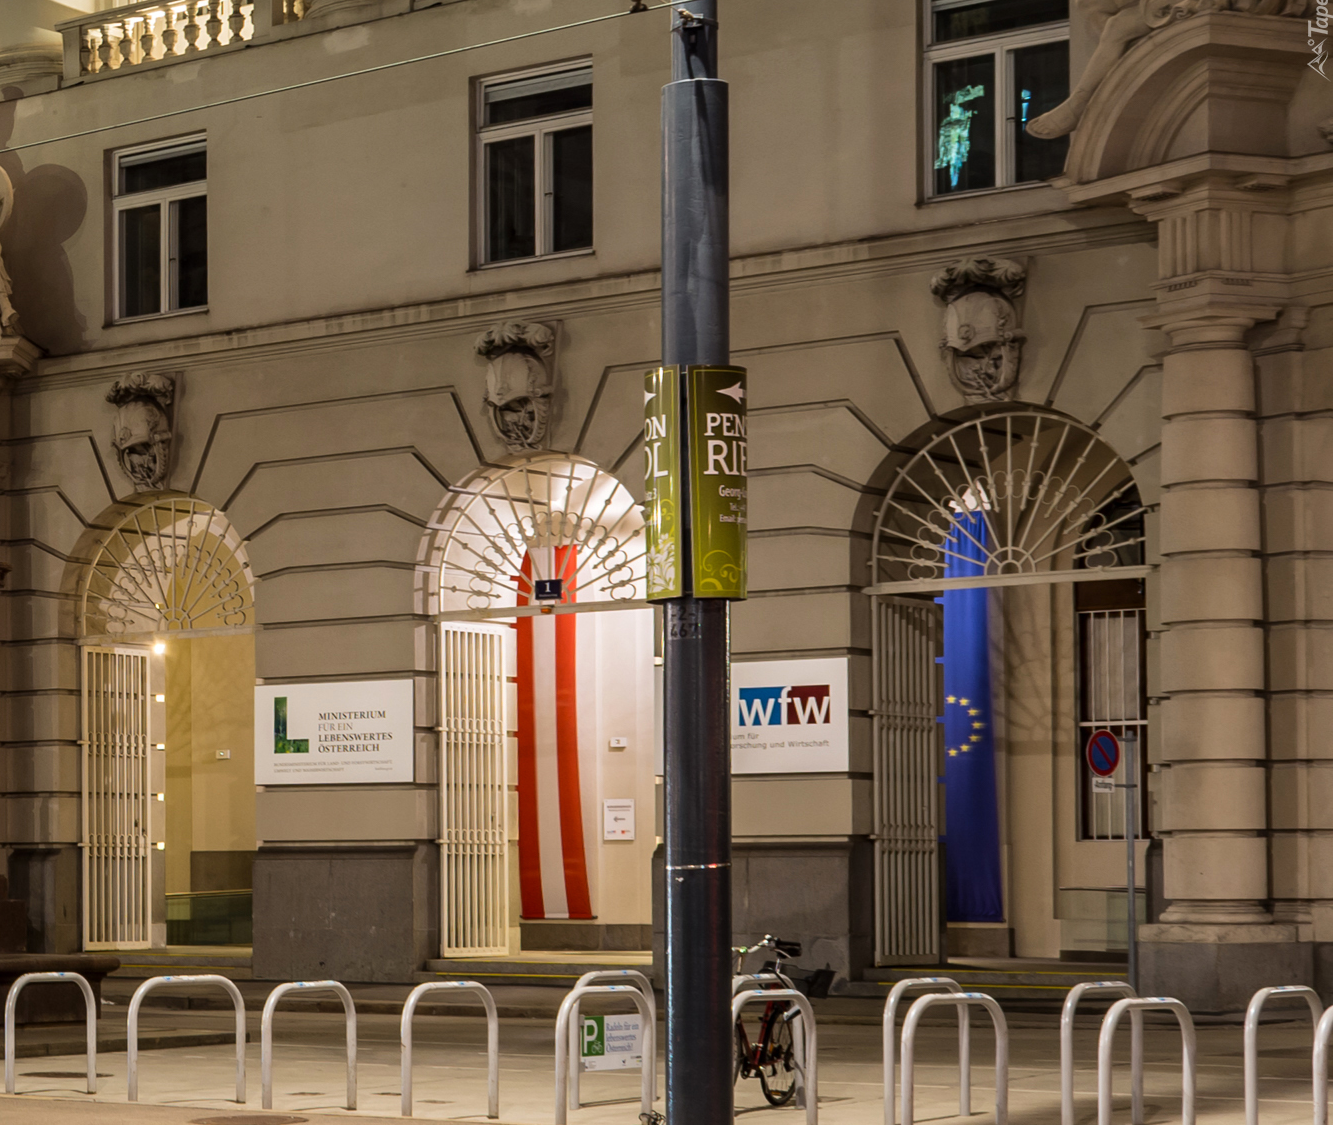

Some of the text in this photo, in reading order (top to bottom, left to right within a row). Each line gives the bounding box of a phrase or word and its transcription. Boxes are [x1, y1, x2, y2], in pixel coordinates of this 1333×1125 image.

[738, 686, 831, 727] wfw
[318, 710, 386, 721] MINISTERIUM
[274, 697, 309, 753] L
[318, 722, 353, 732] FÜR EIN
[318, 732, 393, 743] LEBENSWERTES
[318, 743, 380, 754] ÖSTERREICH
[787, 739, 830, 748] Wirtschaft
[584, 1019, 598, 1053] P
